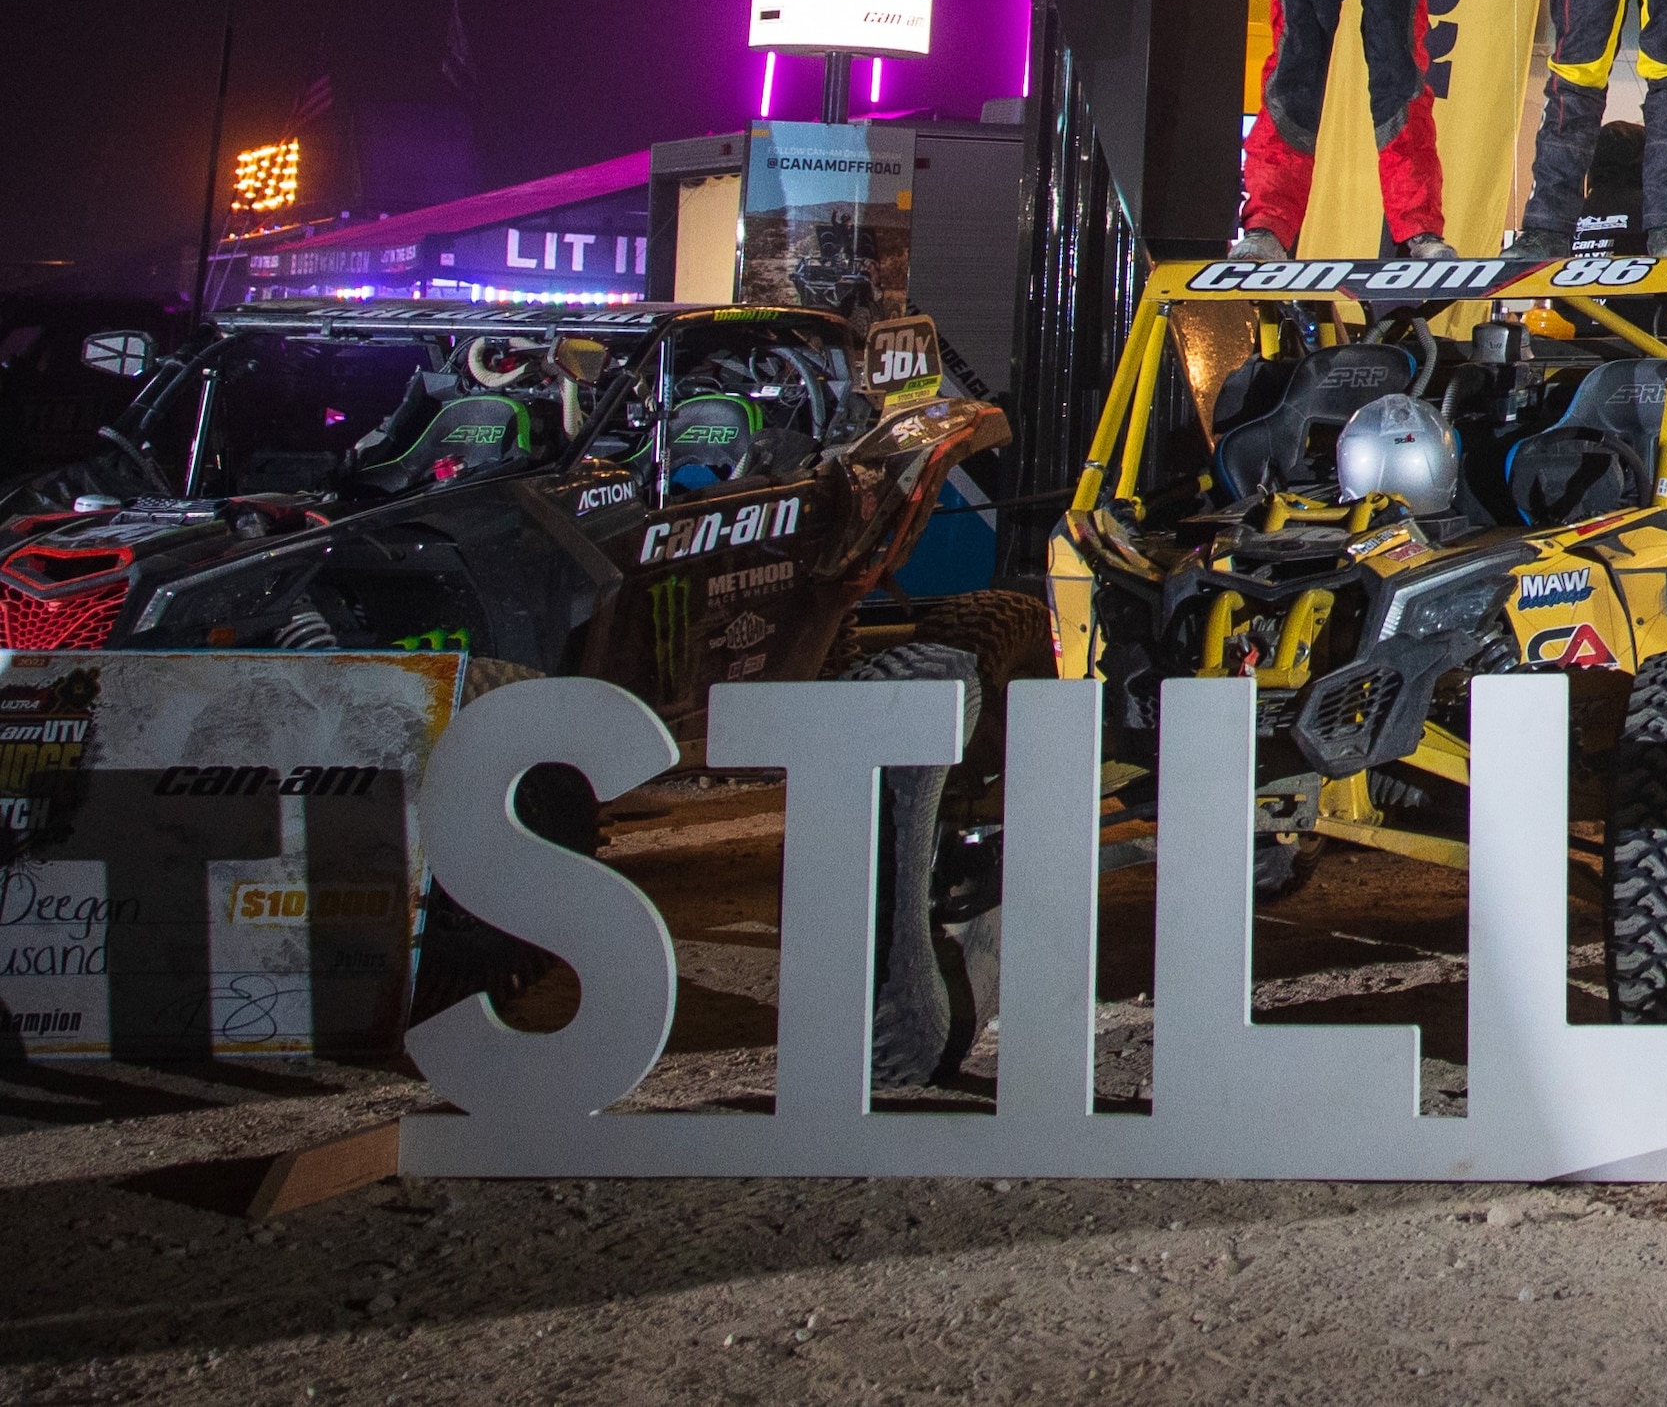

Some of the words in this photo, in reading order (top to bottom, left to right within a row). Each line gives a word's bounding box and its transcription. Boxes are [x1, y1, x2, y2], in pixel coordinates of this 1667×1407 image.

[766, 157, 902, 176] @CANAMOFFROAD
[507, 228, 596, 272] LIT
[1572, 238, 1614, 251] can-am
[1188, 258, 1507, 292] can-am
[1552, 256, 1658, 288] 86
[872, 329, 931, 385] 30X
[576, 481, 637, 516] ACTION
[640, 496, 802, 565] can-am
[707, 560, 795, 598] METHOD
[1520, 566, 1592, 601] MAW
[1, 698, 41, 711] ULTRA
[43, 719, 90, 743] UTV
[153, 765, 380, 797] can-am
